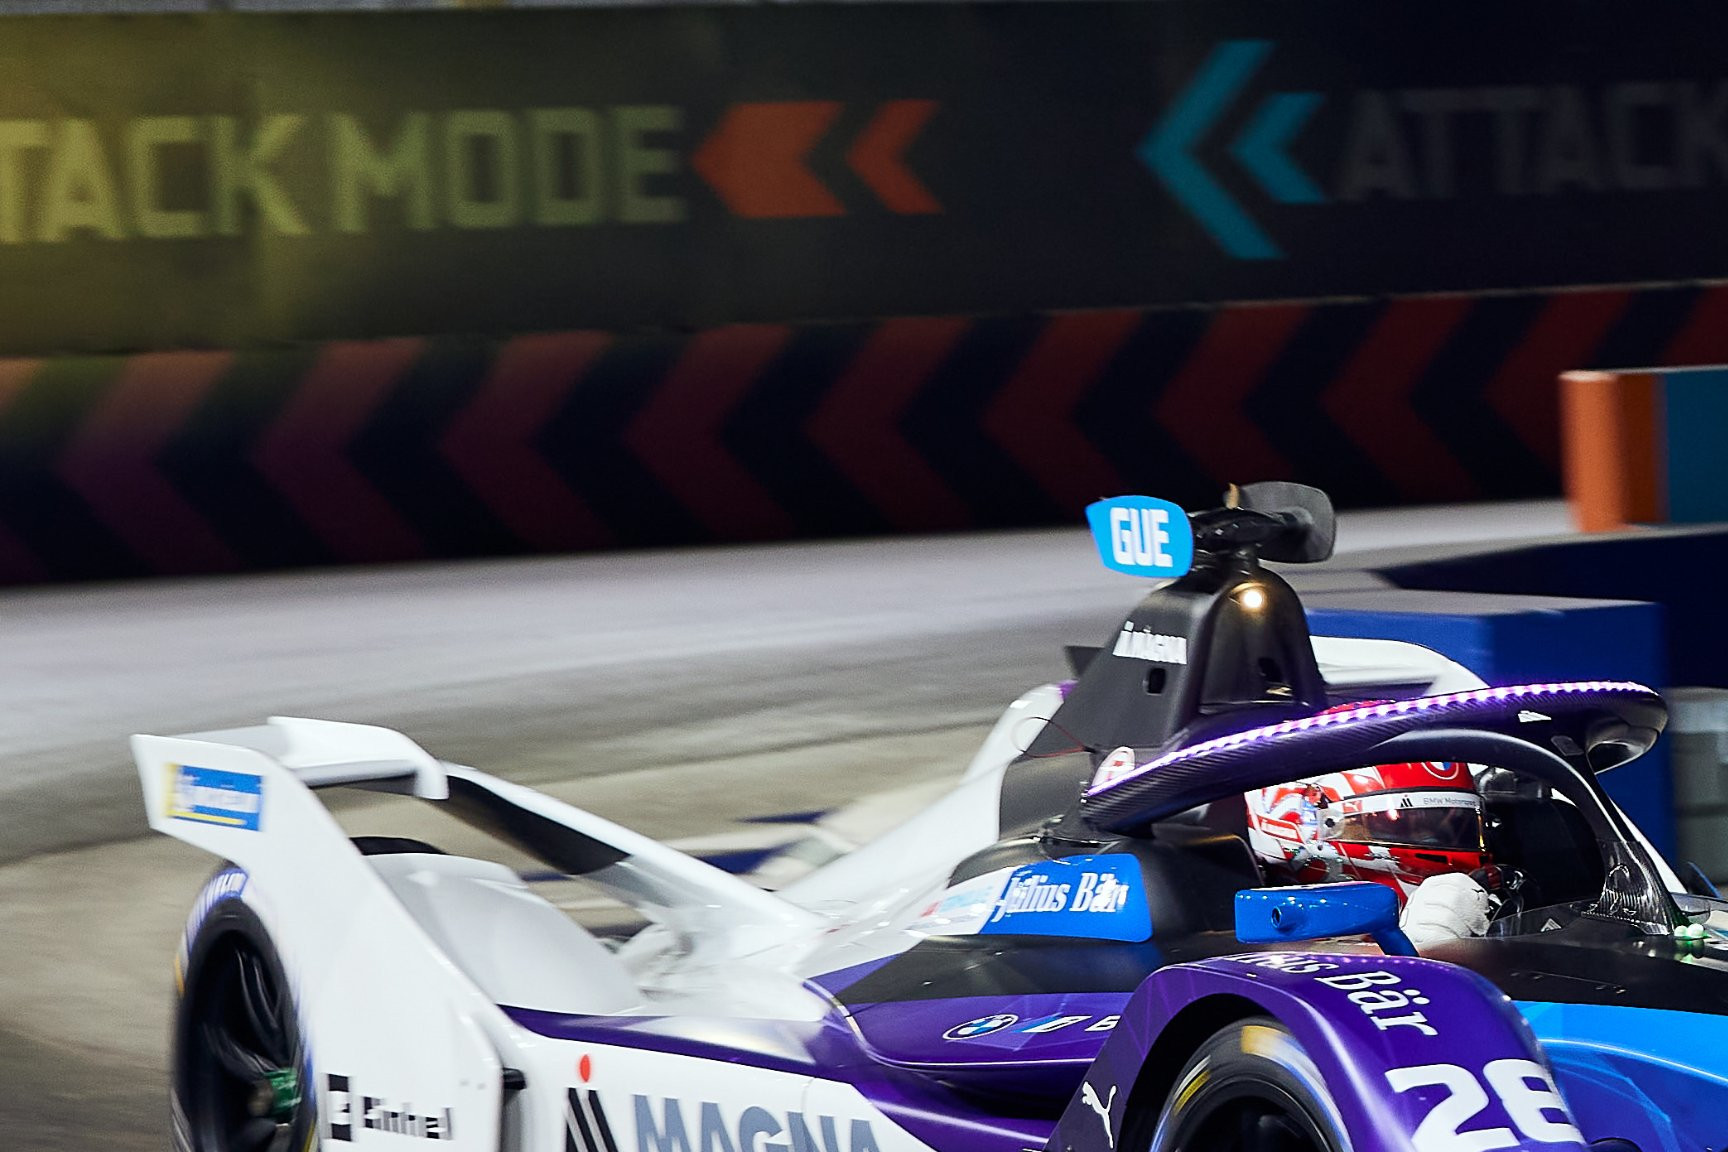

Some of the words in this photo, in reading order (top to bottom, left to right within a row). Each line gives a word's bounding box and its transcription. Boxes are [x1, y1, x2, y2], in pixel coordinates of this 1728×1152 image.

[324, 105, 690, 234] MODE
[1109, 506, 1174, 568] GUE
[1315, 969, 1438, 1037] Bär
